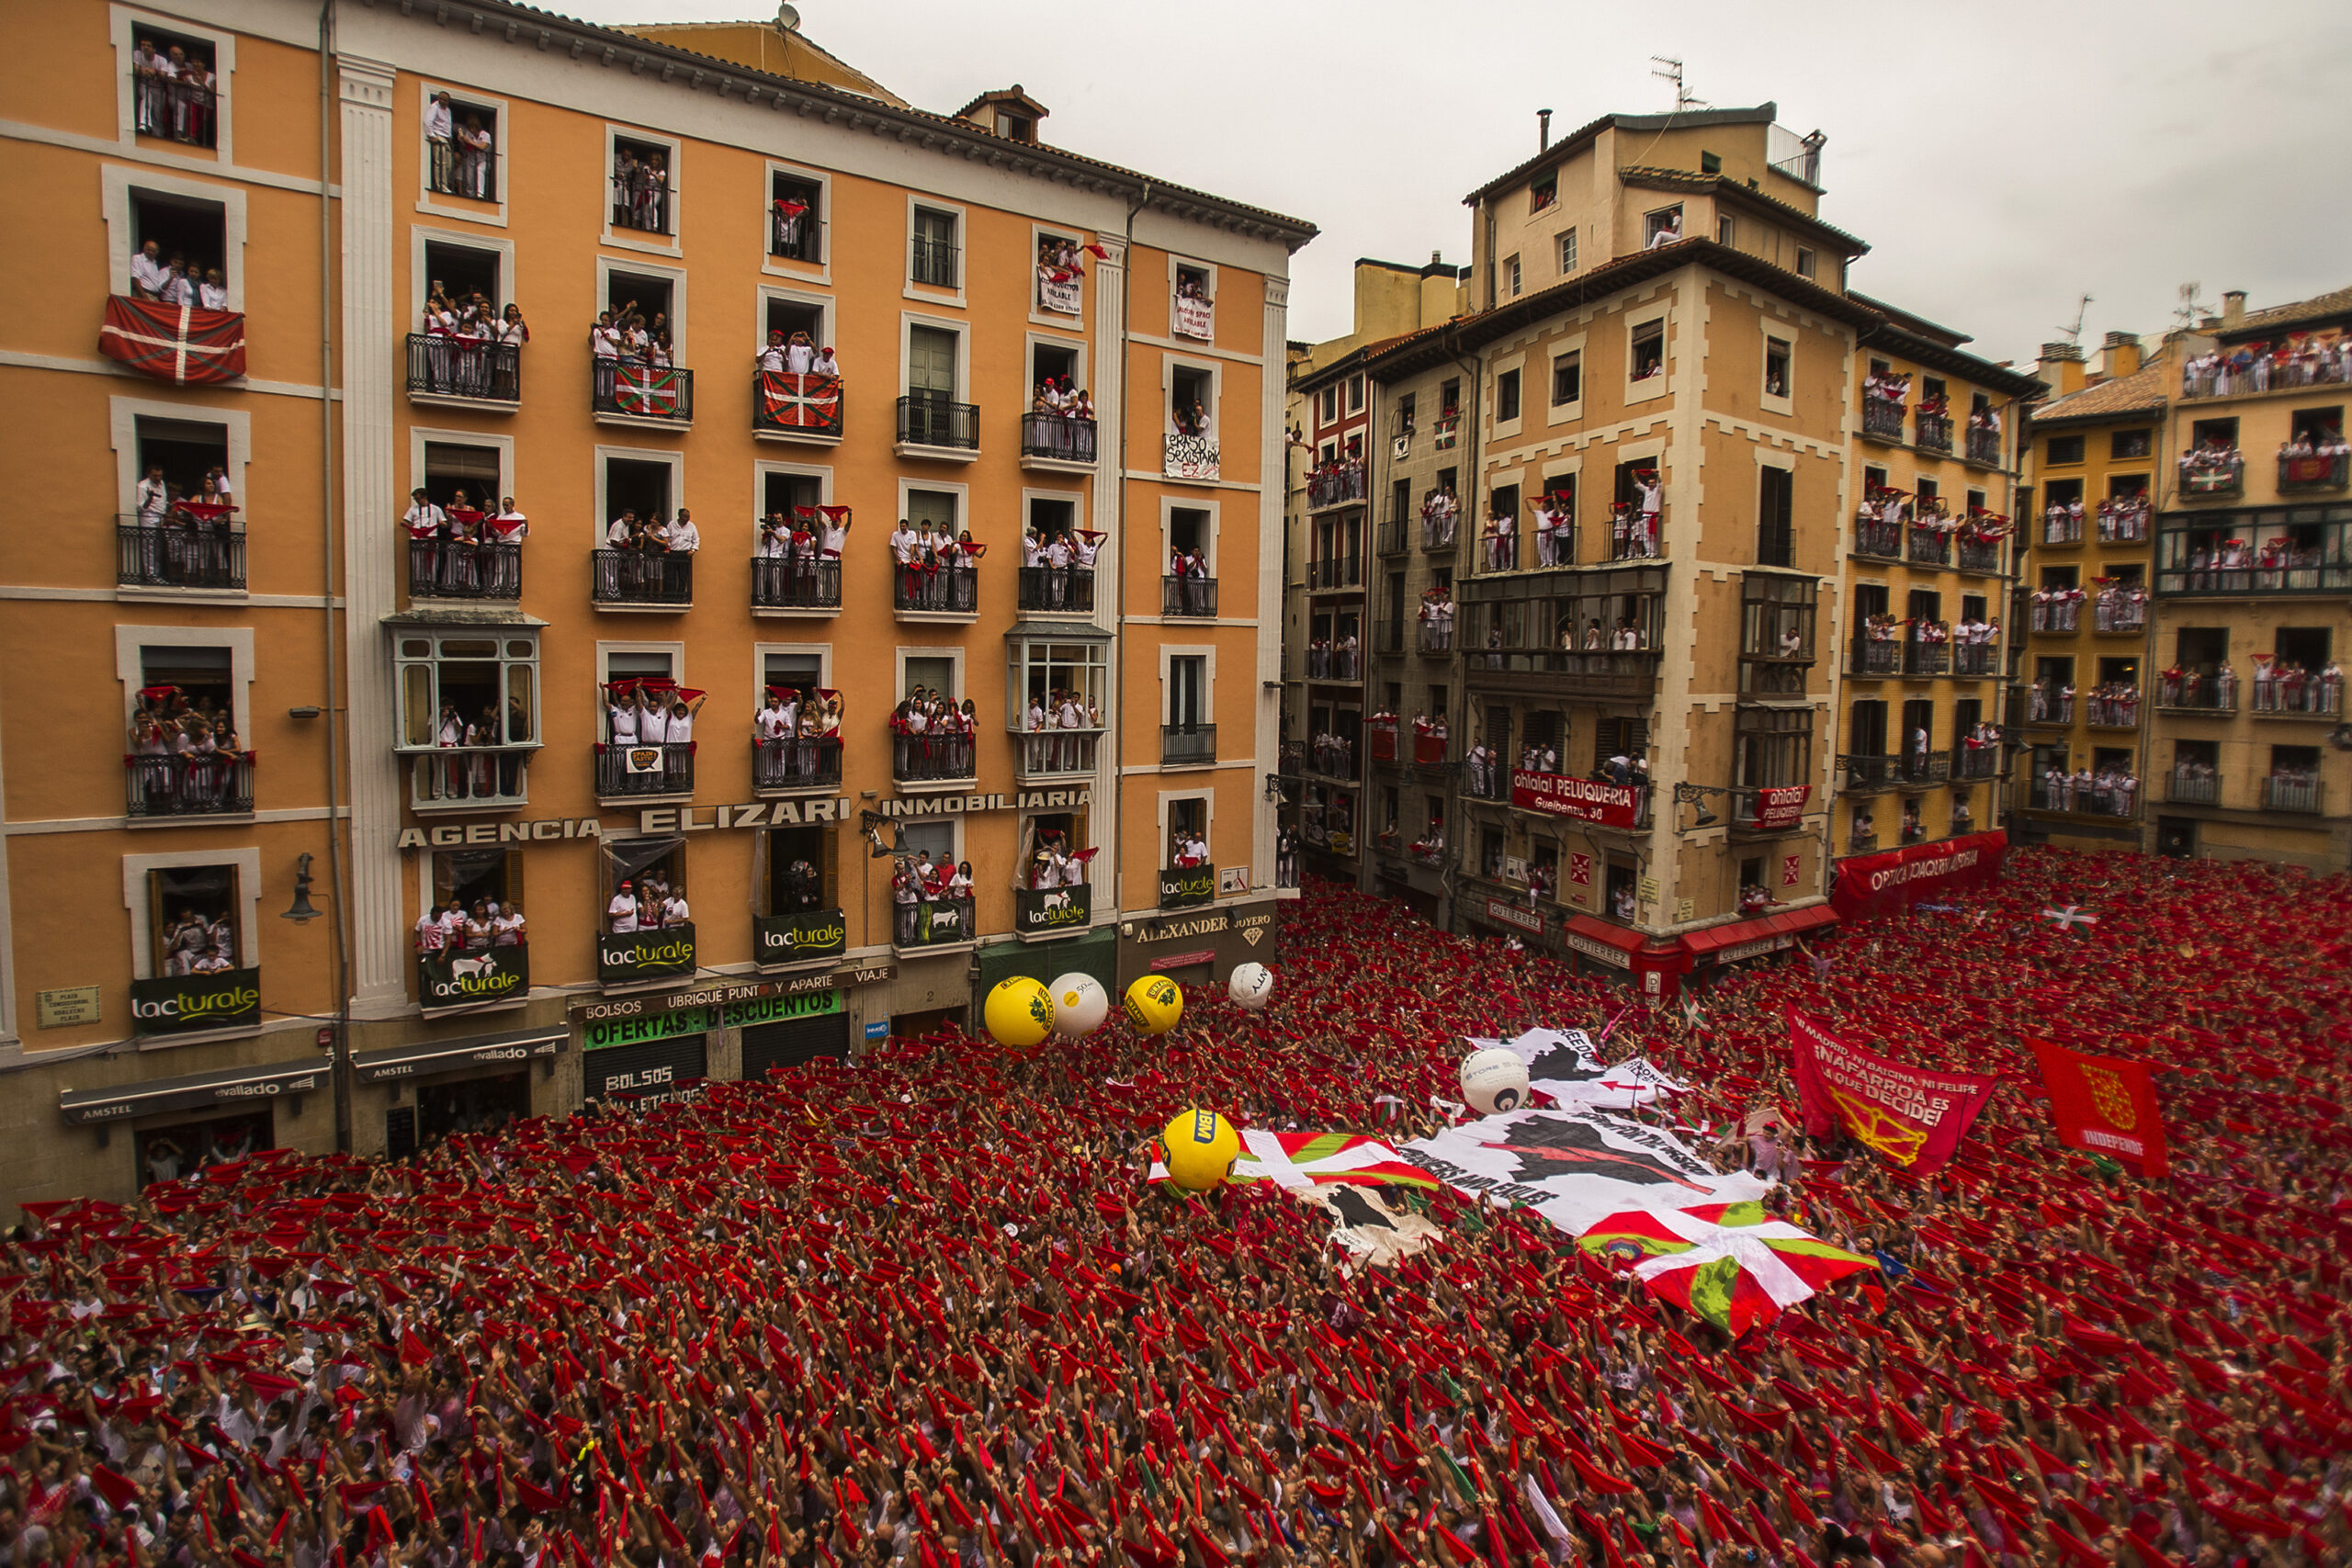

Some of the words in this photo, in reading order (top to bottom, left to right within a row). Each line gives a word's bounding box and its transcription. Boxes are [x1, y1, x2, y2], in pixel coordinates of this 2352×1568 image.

[1182, 462, 1199, 479] EZ
[1514, 772, 1553, 794] ohlala!
[640, 797, 851, 834] ELIZARI
[882, 790, 1095, 817] INMOBILIARIA
[1589, 807, 1603, 820] 30
[396, 818, 603, 848] AGENCIA
[1161, 875, 1215, 895] lacturale
[1030, 905, 1085, 925] lacturale
[1491, 903, 1540, 929] GUTIERREZ
[764, 924, 844, 949] lacturale
[1136, 916, 1228, 944] ALEXANDER
[1233, 914, 1271, 929] JOYERO
[603, 941, 694, 967] lacturale
[1572, 936, 1627, 965] GUTIERREZ
[1723, 940, 1770, 960] GUTIERREZ
[431, 972, 520, 998] lacturale
[586, 1000, 642, 1020] BOLSOS
[668, 990, 723, 1009] UBRIQUE
[775, 982, 784, 993] Y
[789, 976, 833, 992] APARTE
[854, 967, 889, 984] VIAJE
[926, 991, 934, 1002] 2
[131, 986, 260, 1021] lacturale
[593, 1011, 688, 1045] OFERTAS
[707, 990, 833, 1028] DESCUENTOS
[373, 1065, 414, 1079] AMSTEL
[1804, 1025, 1850, 1059] MADRID,
[1852, 1054, 1867, 1066] NI
[1921, 1078, 1937, 1090] NI
[1938, 1082, 1979, 1096] FELIPE
[605, 1066, 673, 1091] BOLSOS
[82, 1104, 133, 1120] AMSTEL
[1834, 1072, 1863, 1092] QUE
[1865, 1083, 1944, 1128] DECIDE!
[1931, 1097, 1951, 1111] ES
